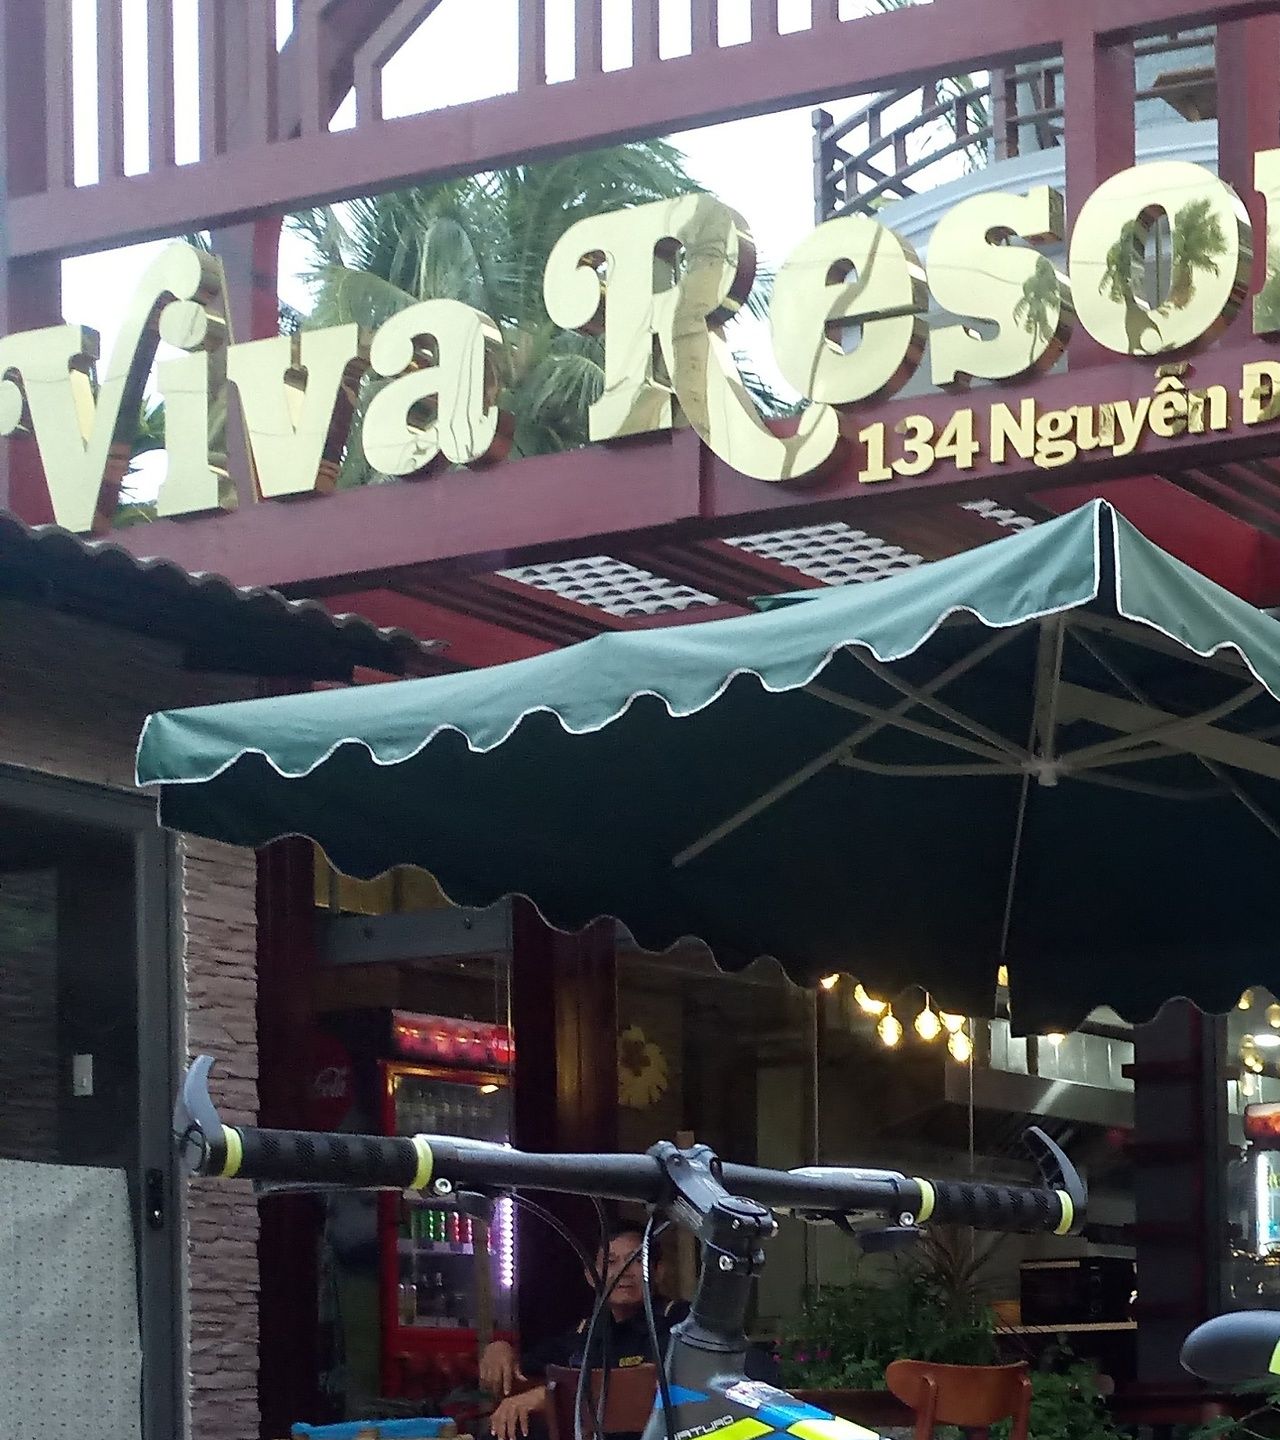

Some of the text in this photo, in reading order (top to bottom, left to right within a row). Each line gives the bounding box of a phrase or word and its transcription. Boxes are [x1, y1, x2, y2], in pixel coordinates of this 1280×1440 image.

[0, 239, 513, 533] Viva
[856, 418, 981, 483] 134
[989, 362, 1227, 472] Nguyễn
